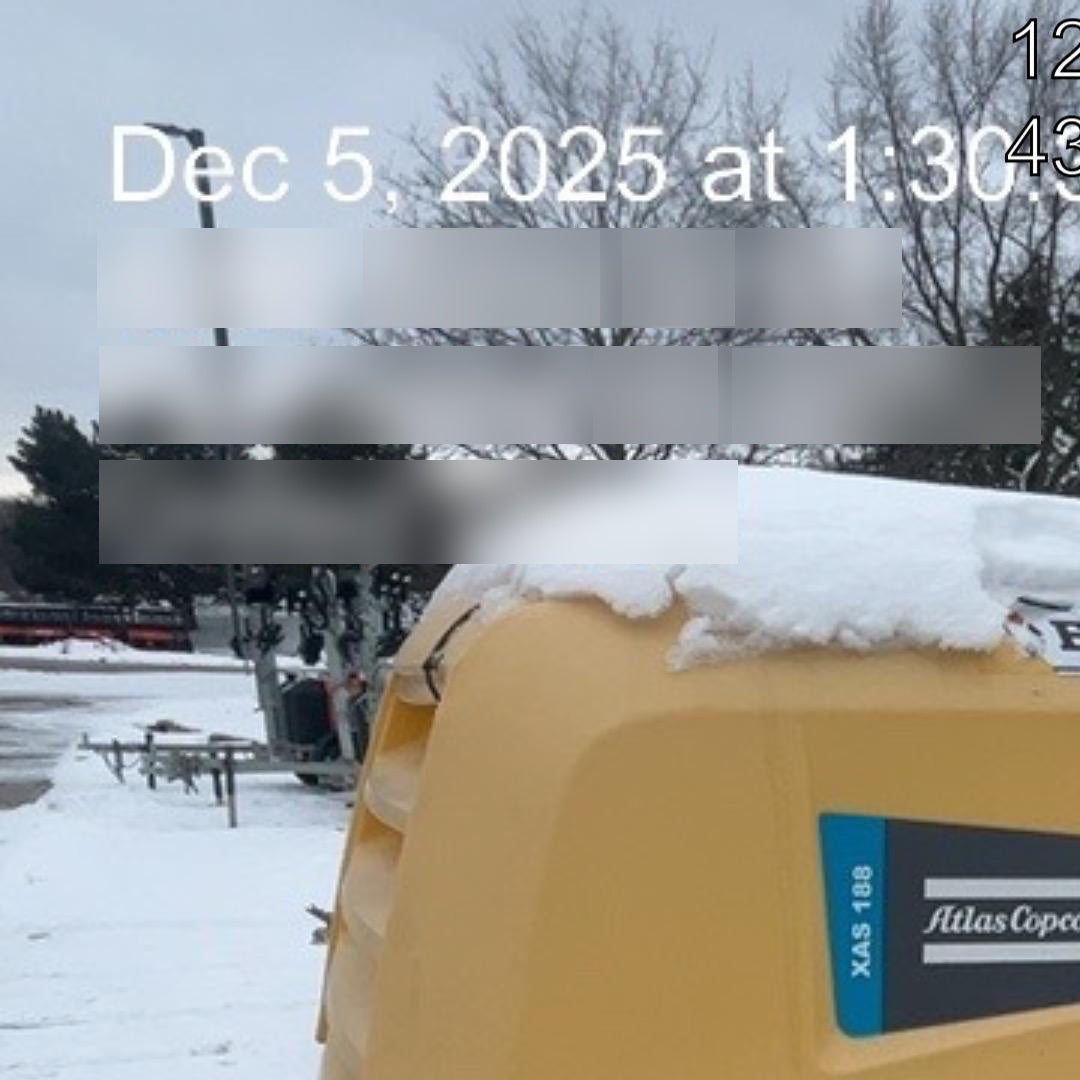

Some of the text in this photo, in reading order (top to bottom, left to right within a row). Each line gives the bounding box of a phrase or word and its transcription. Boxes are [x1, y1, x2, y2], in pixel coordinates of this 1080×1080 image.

[851, 864, 874, 978] XAS 188
[922, 905, 1007, 935] Atlas
